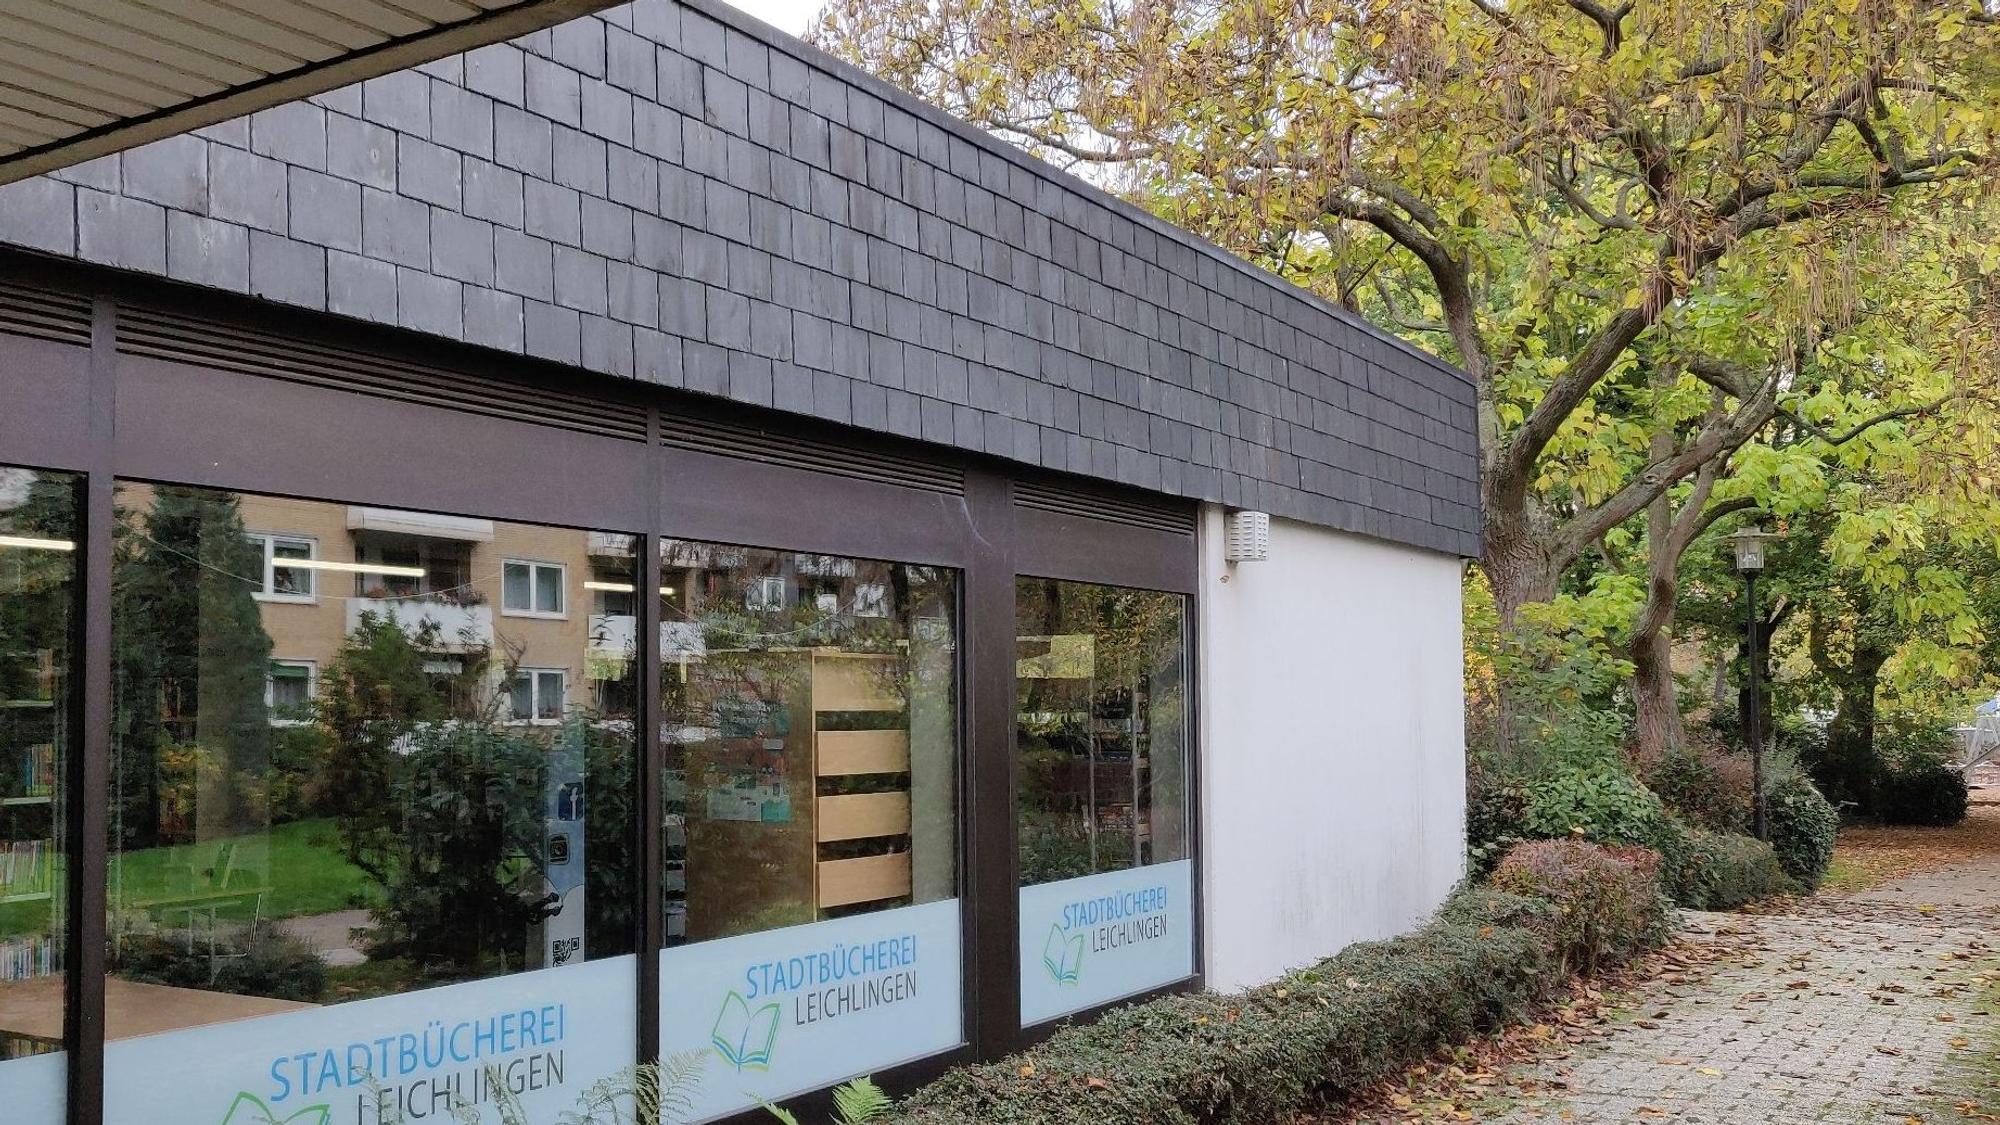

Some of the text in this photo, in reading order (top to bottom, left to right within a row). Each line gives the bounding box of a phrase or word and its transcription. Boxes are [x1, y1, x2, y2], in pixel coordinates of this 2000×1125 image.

[1063, 886, 1167, 930] STADTBÜCHEREI
[1092, 913, 1167, 953] LEICHLINGEN
[746, 934, 916, 999] STADTBÜCHEREI
[796, 970, 917, 1026] LEICHLINGEN
[270, 1004, 564, 1101] STADTBÜCHEREI
